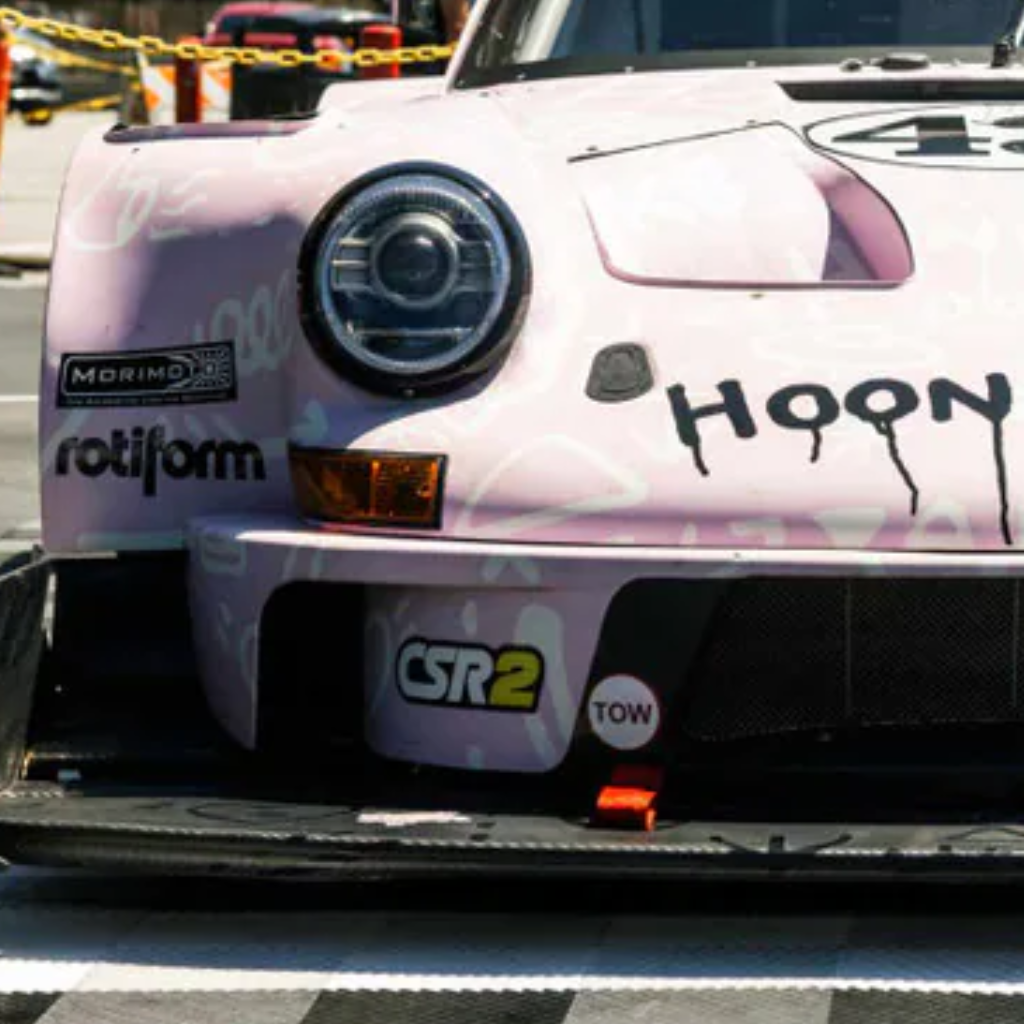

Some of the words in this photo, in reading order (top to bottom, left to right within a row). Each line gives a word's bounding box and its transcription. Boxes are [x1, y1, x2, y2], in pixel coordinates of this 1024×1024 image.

[56, 425, 266, 497] rotiform
[399, 640, 543, 709] CSR2
[593, 701, 652, 725] TOW
